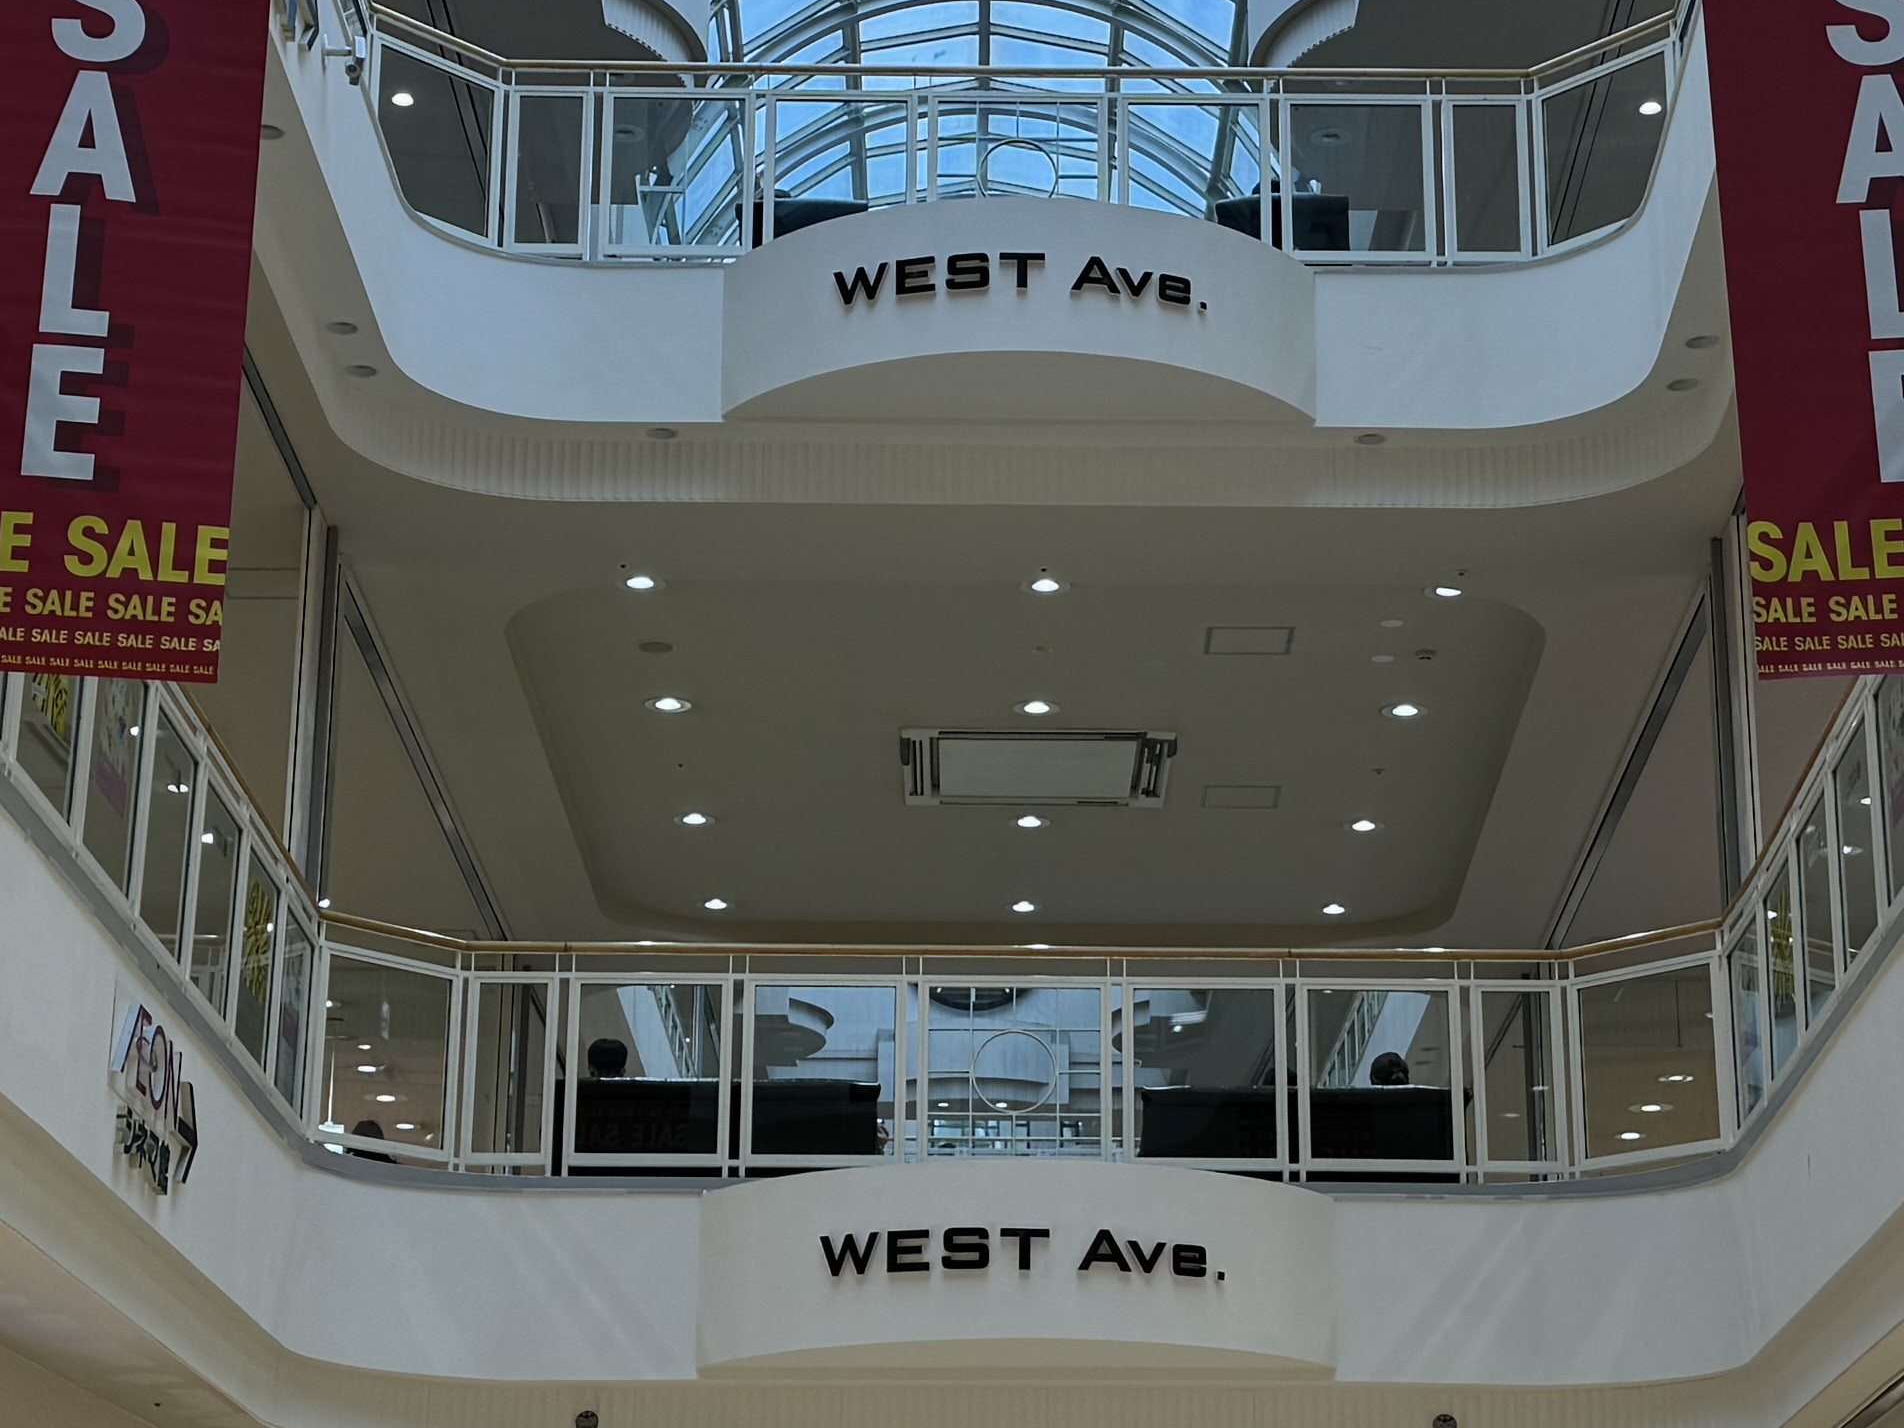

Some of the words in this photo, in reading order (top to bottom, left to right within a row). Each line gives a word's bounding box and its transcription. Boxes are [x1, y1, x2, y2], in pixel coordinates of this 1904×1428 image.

[832, 252, 1046, 305] WEST
[1070, 255, 1209, 312] Ave.
[63, 515, 228, 586] SALE
[24, 587, 95, 618] SALE
[106, 593, 176, 622] SALE
[1753, 596, 1817, 623] SALE
[1828, 593, 1899, 622] SALE
[31, 628, 68, 644] SALE
[73, 630, 112, 646] SALE
[117, 633, 154, 649] SALE
[160, 636, 197, 651] SALE
[1794, 635, 1831, 651] SALE
[1837, 634, 1874, 649] SALE
[819, 1226, 1051, 1277] WEST
[1077, 1228, 1225, 1281] Ave.
